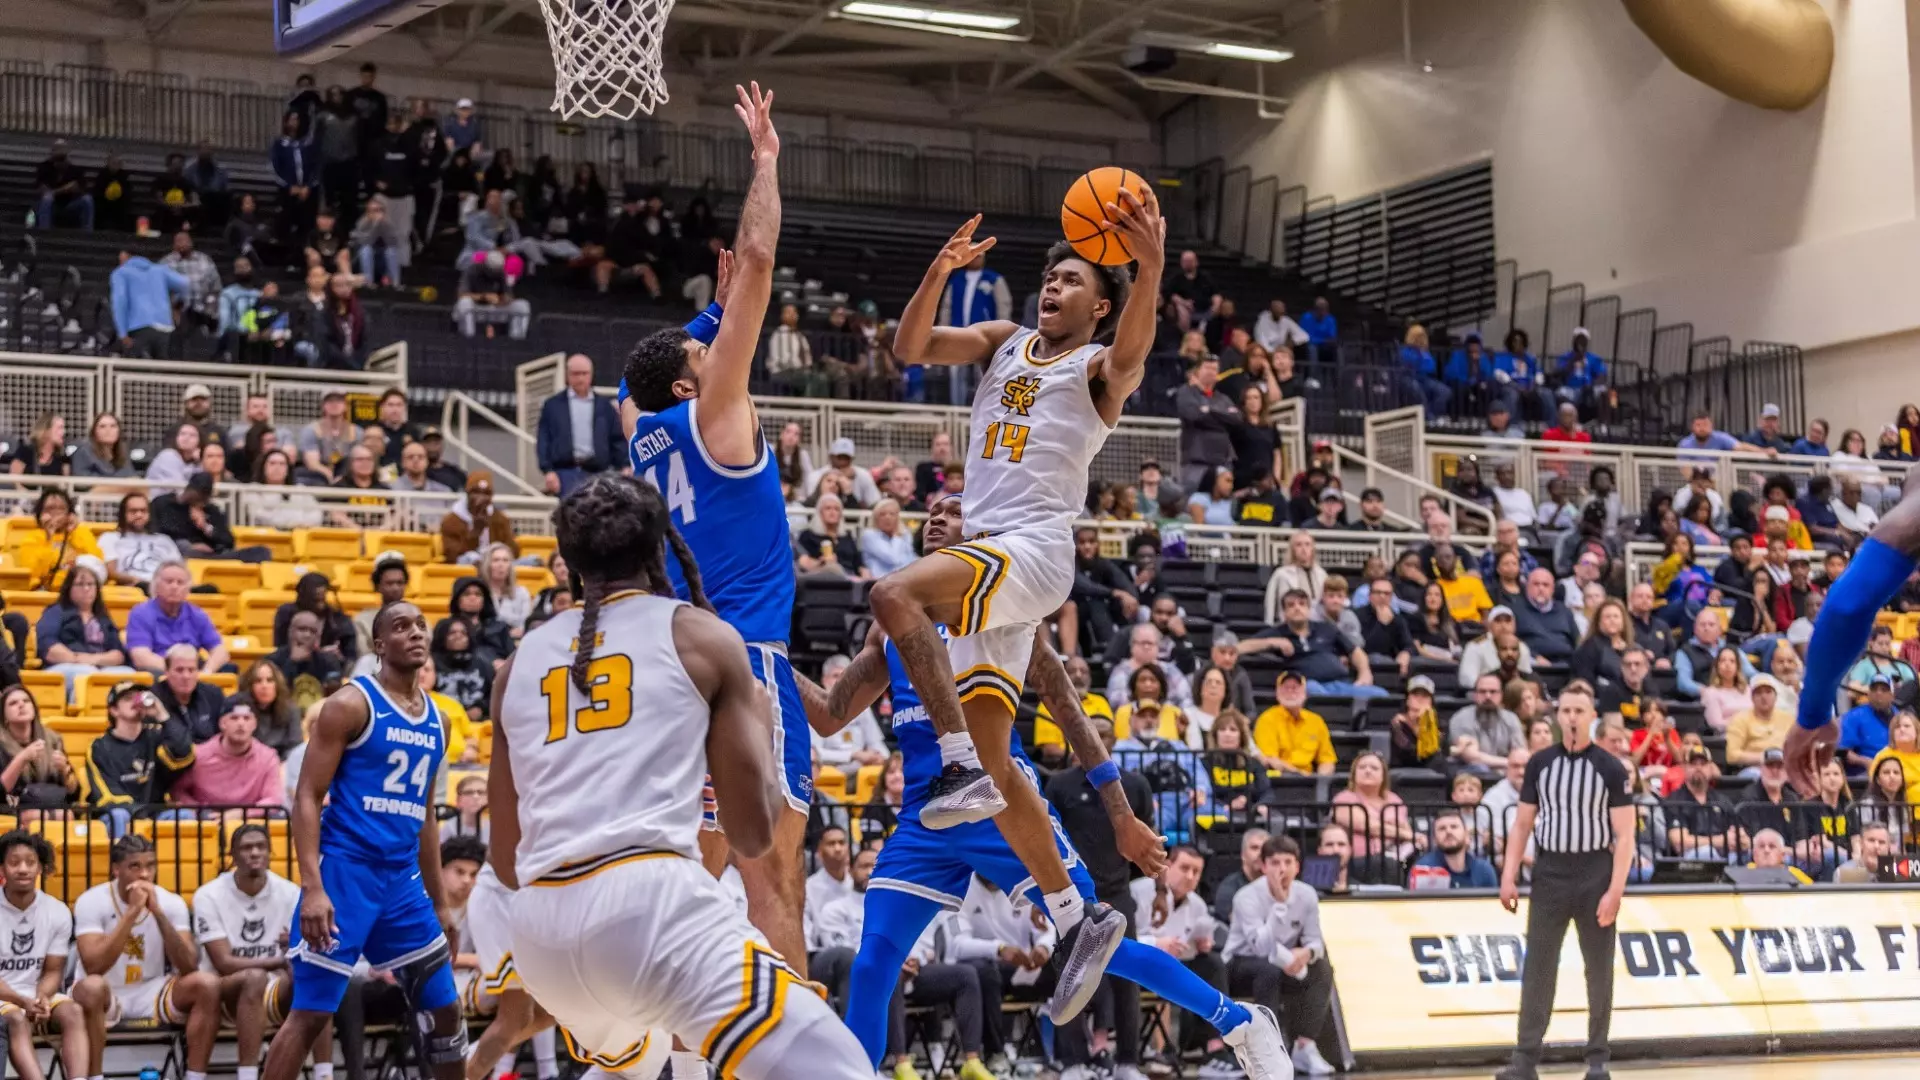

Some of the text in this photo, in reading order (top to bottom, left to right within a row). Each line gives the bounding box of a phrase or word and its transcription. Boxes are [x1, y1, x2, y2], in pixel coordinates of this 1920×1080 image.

[981, 421, 1031, 463] 14
[541, 652, 633, 746] 13
[386, 726, 436, 750] MIDDLE
[383, 748, 431, 798] 24
[1410, 924, 1920, 984] SHO OR YOUR F
